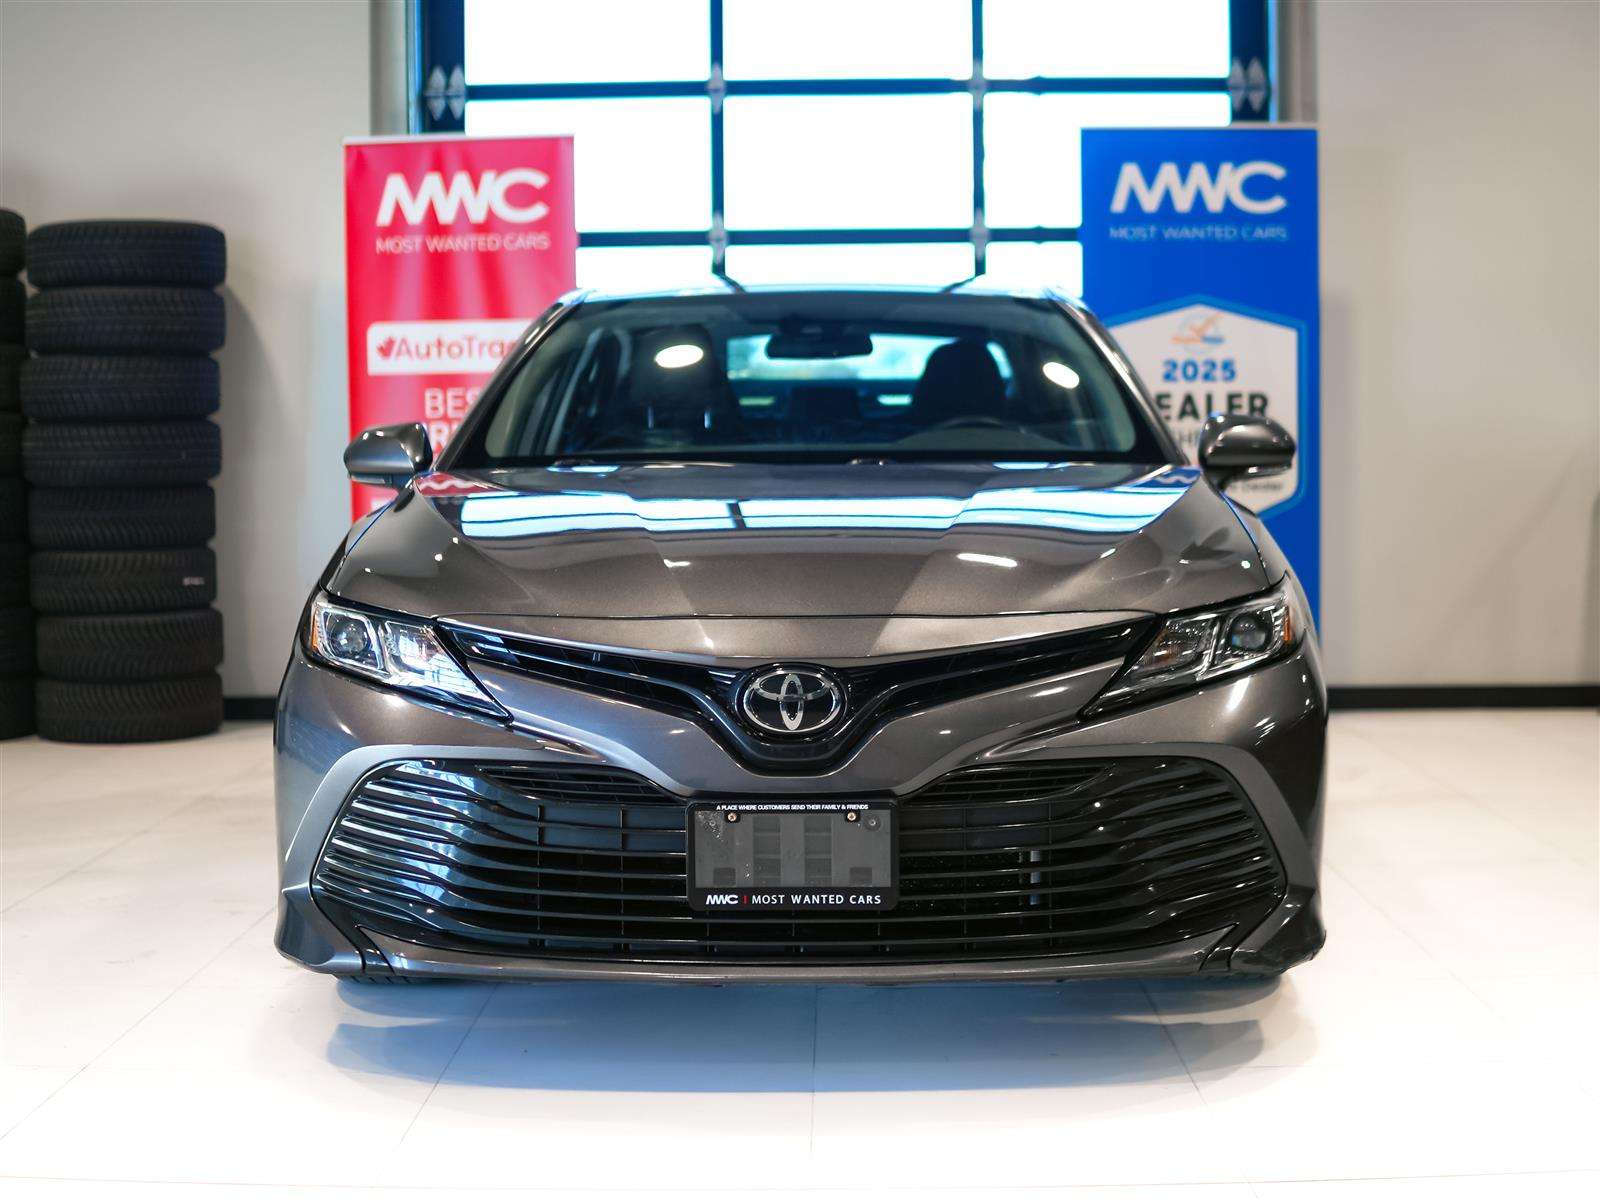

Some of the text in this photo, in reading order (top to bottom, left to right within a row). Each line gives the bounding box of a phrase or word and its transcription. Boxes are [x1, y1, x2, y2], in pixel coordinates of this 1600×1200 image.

[375, 168, 550, 227] MWC
[1110, 161, 1287, 214] MWC
[376, 231, 549, 254] MOST WANTED CARS
[1109, 224, 1288, 240] MOST WANTED CARS
[396, 335, 517, 361] AutoTra
[1162, 358, 1237, 382] 2025
[1154, 392, 1269, 420] EALER
[706, 894, 882, 905] MWC MOST WANTED CARS
